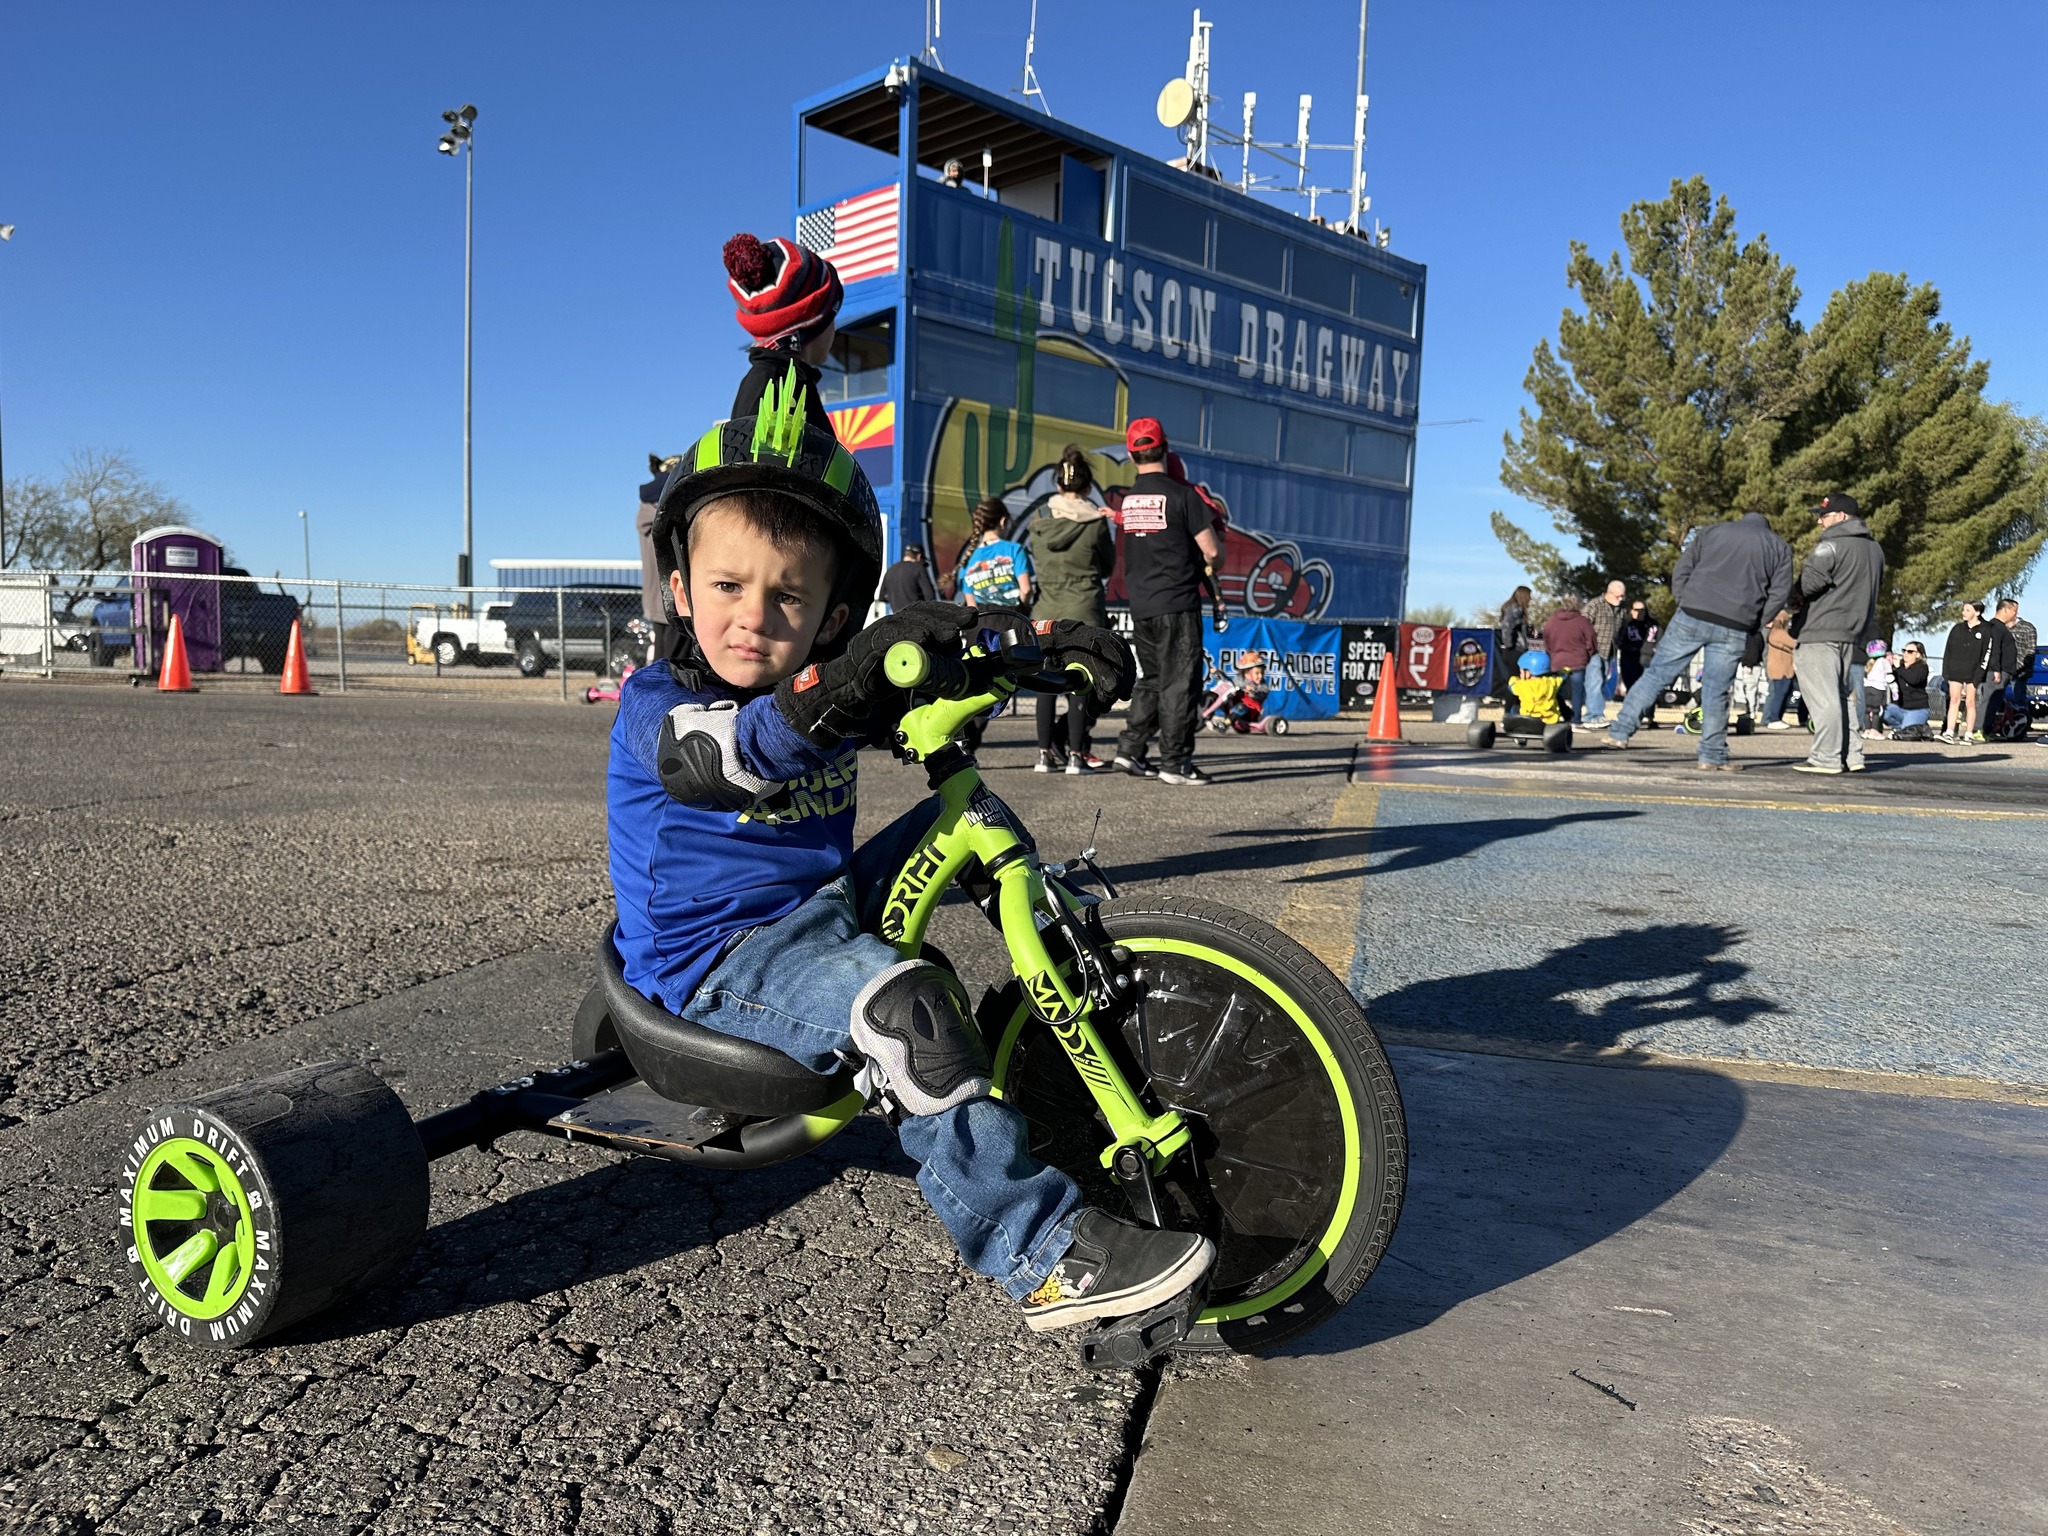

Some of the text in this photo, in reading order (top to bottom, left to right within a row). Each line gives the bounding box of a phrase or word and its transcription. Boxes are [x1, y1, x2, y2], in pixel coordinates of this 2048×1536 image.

[1034, 236, 1409, 417] TUCSON DRAGWAY
[1220, 648, 1335, 676] PUH RIDGE
[1342, 662, 1382, 681] FOR AL
[1348, 641, 1386, 661] SPEED
[1029, 970, 1087, 1055] MADD
[119, 1116, 249, 1227] MAXIMUM DRIFT
[139, 1229, 271, 1341] MAXIMUM DRIFT
